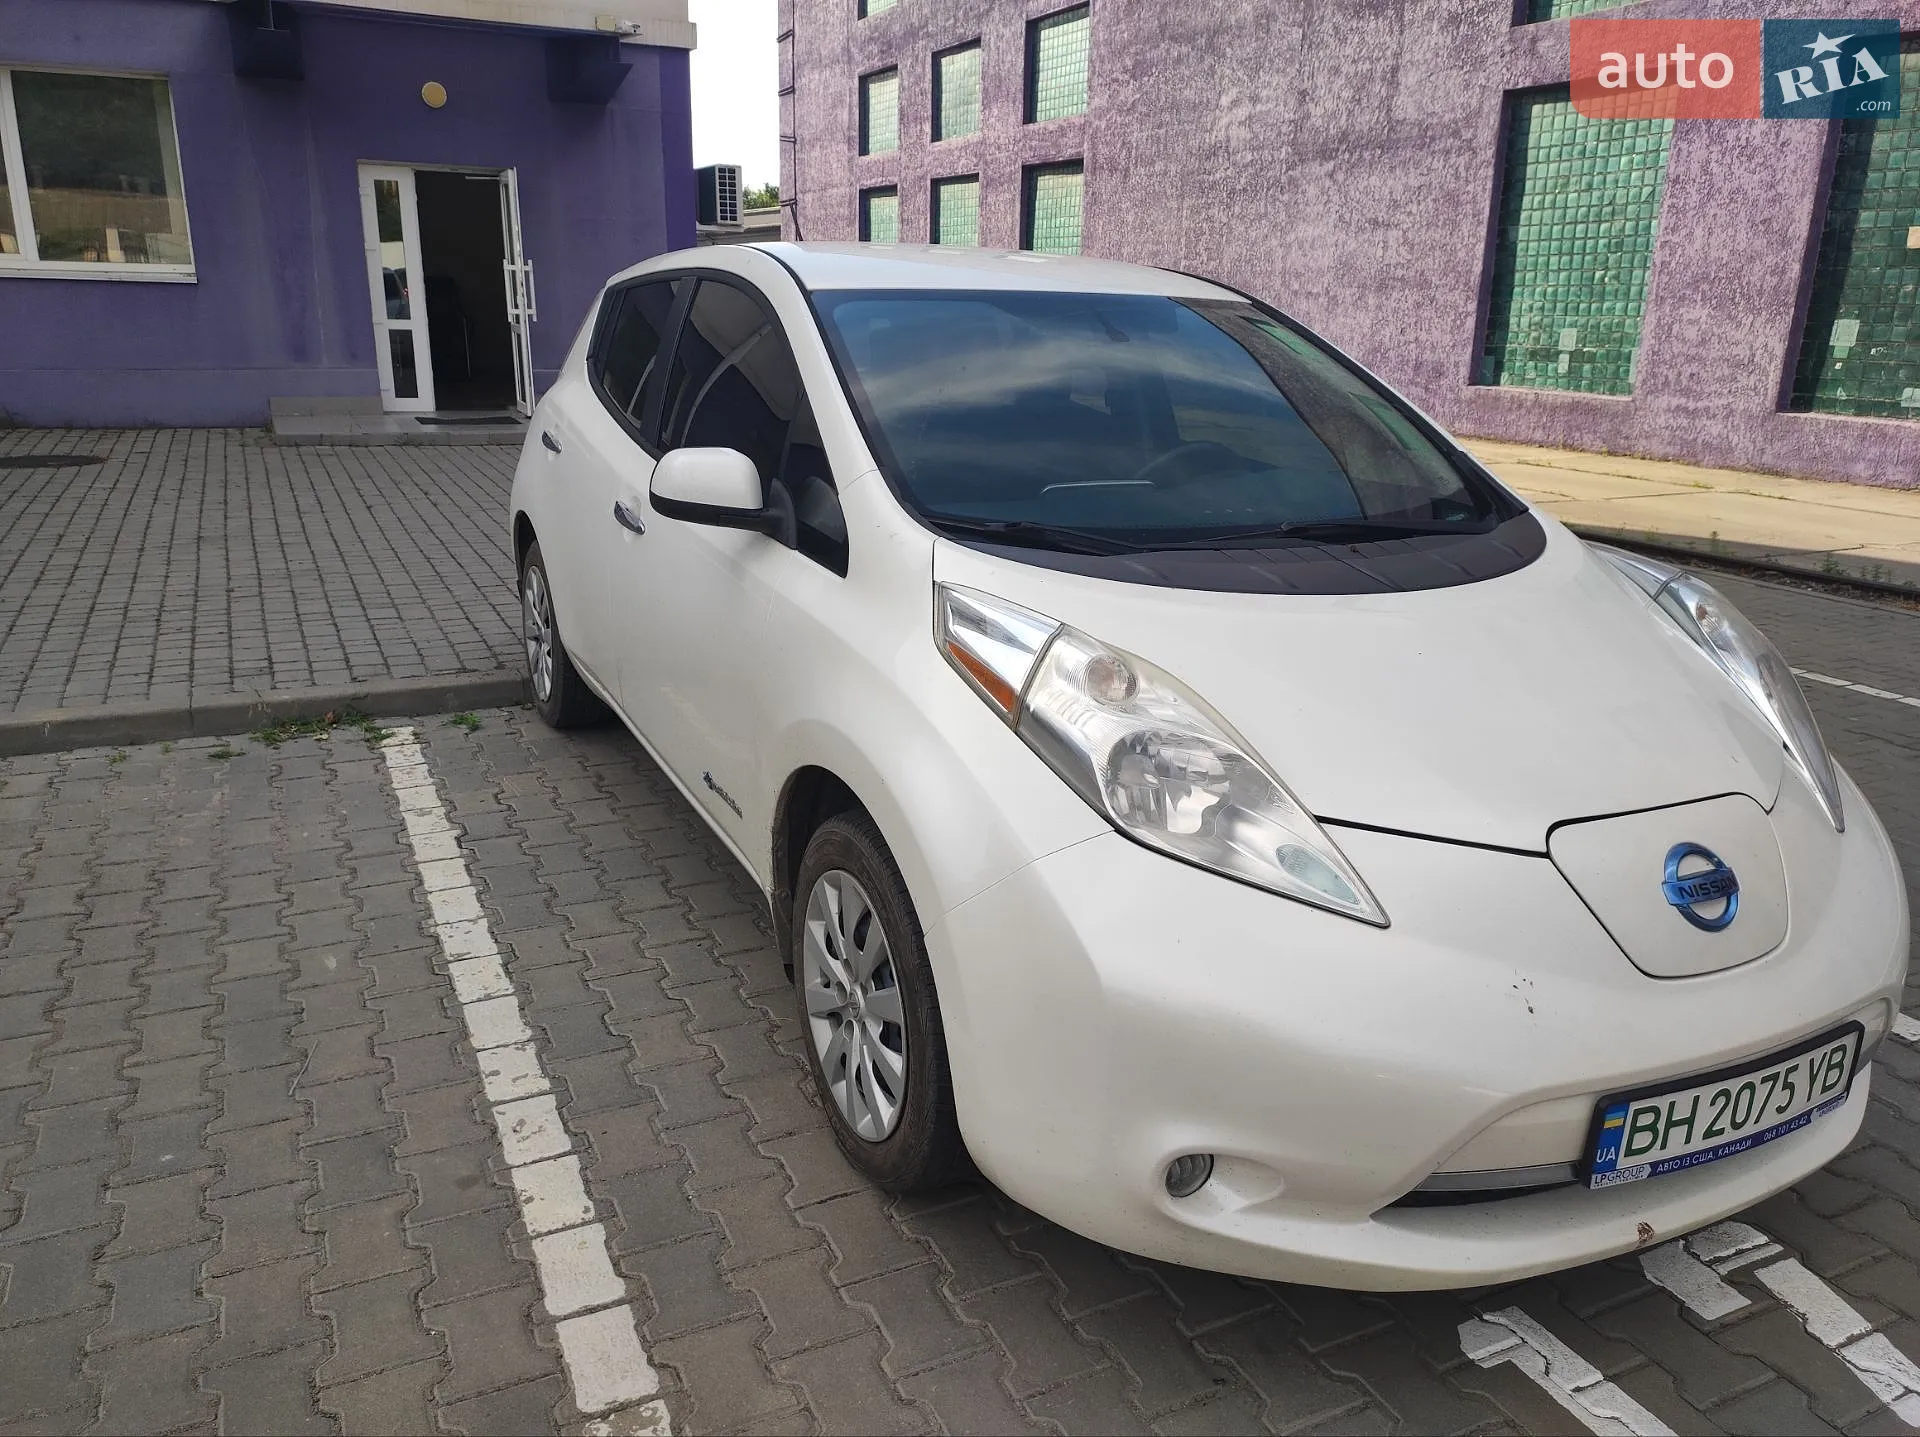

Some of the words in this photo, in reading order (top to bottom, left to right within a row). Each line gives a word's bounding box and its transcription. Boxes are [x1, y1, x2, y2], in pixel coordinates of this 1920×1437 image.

[1677, 876, 1738, 900] NISSAN
[1623, 1094, 1702, 1158] BH
[1702, 1063, 1800, 1141] 2075
[1806, 1043, 1848, 1104] YB
[1596, 1146, 1616, 1163] UA
[1656, 1160, 1681, 1173] АВТО
[1718, 1139, 1753, 1157] КАНАДИ
